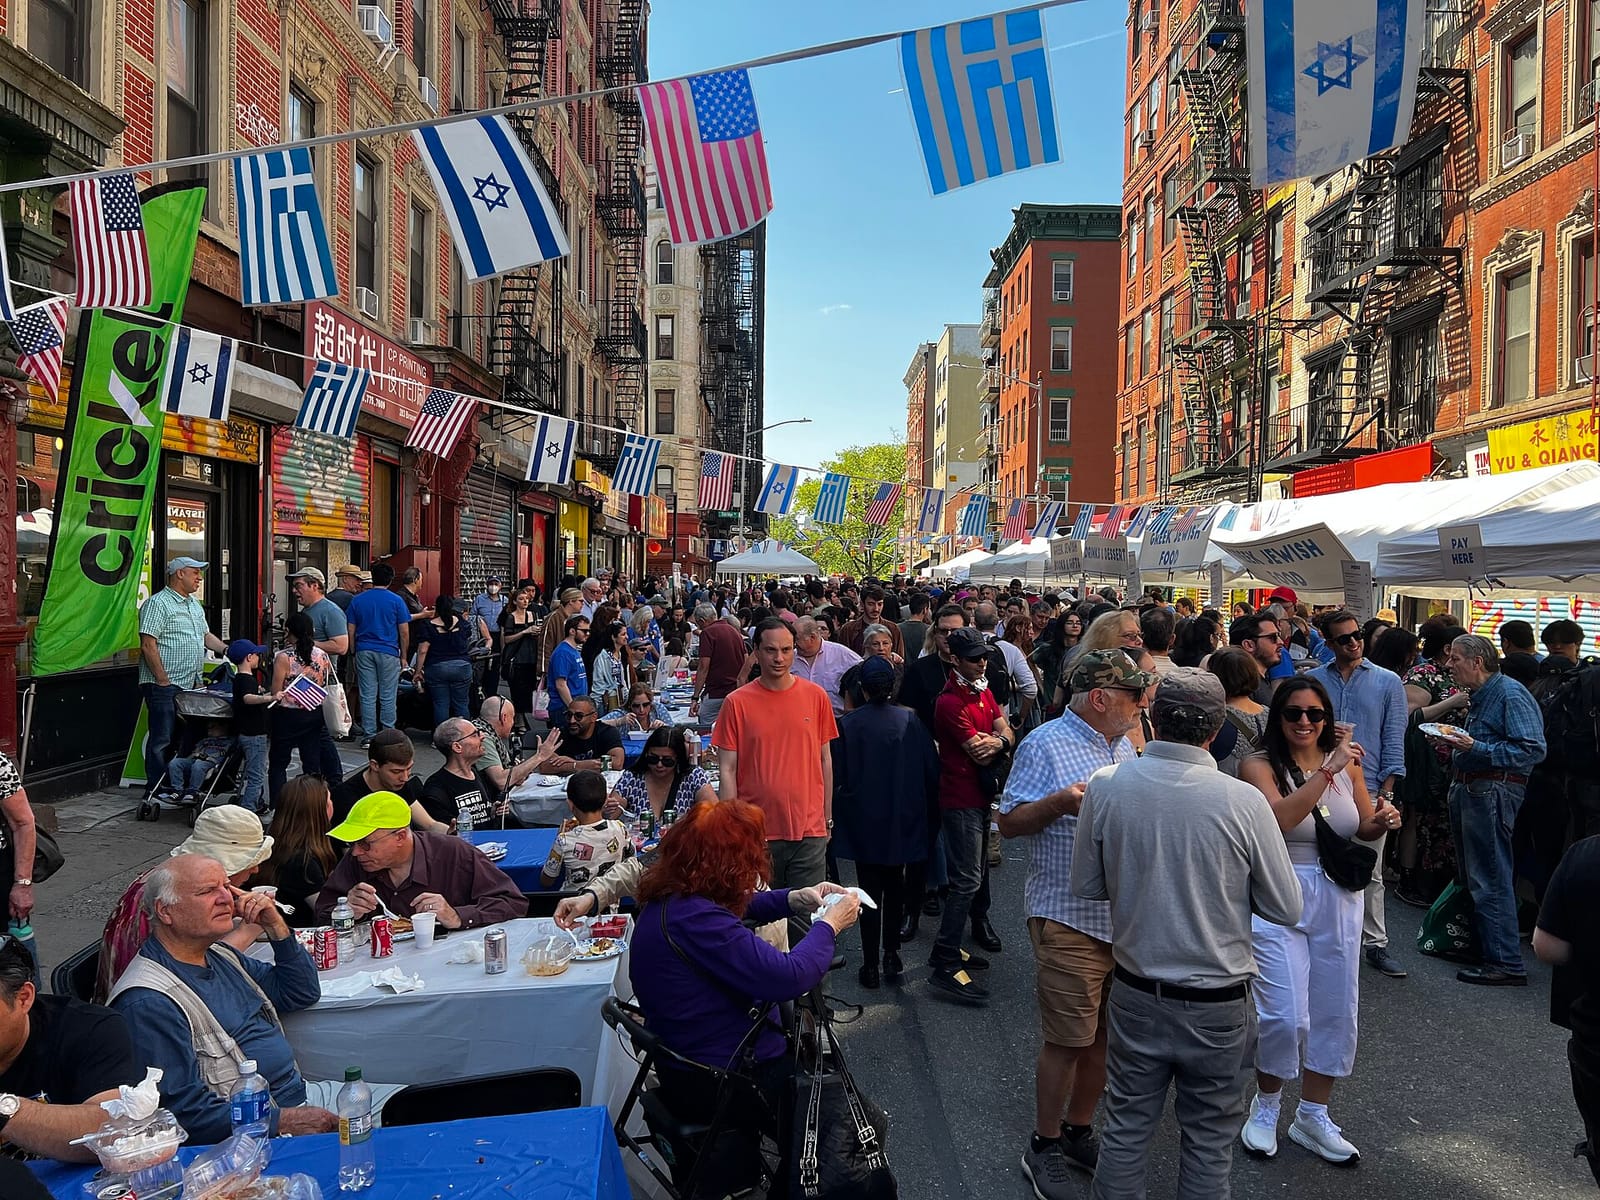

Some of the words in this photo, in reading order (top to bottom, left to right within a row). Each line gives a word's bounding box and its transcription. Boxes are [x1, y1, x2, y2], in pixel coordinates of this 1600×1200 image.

[387, 347, 398, 362] CP
[398, 353, 427, 379] PRINTING
[1495, 455, 1516, 472] YU
[1521, 453, 1532, 468] &
[1538, 442, 1596, 466] QIANG
[1260, 538, 1325, 566] JEWISH
[1451, 537, 1468, 549] PAY
[1451, 552, 1474, 565] HERE
